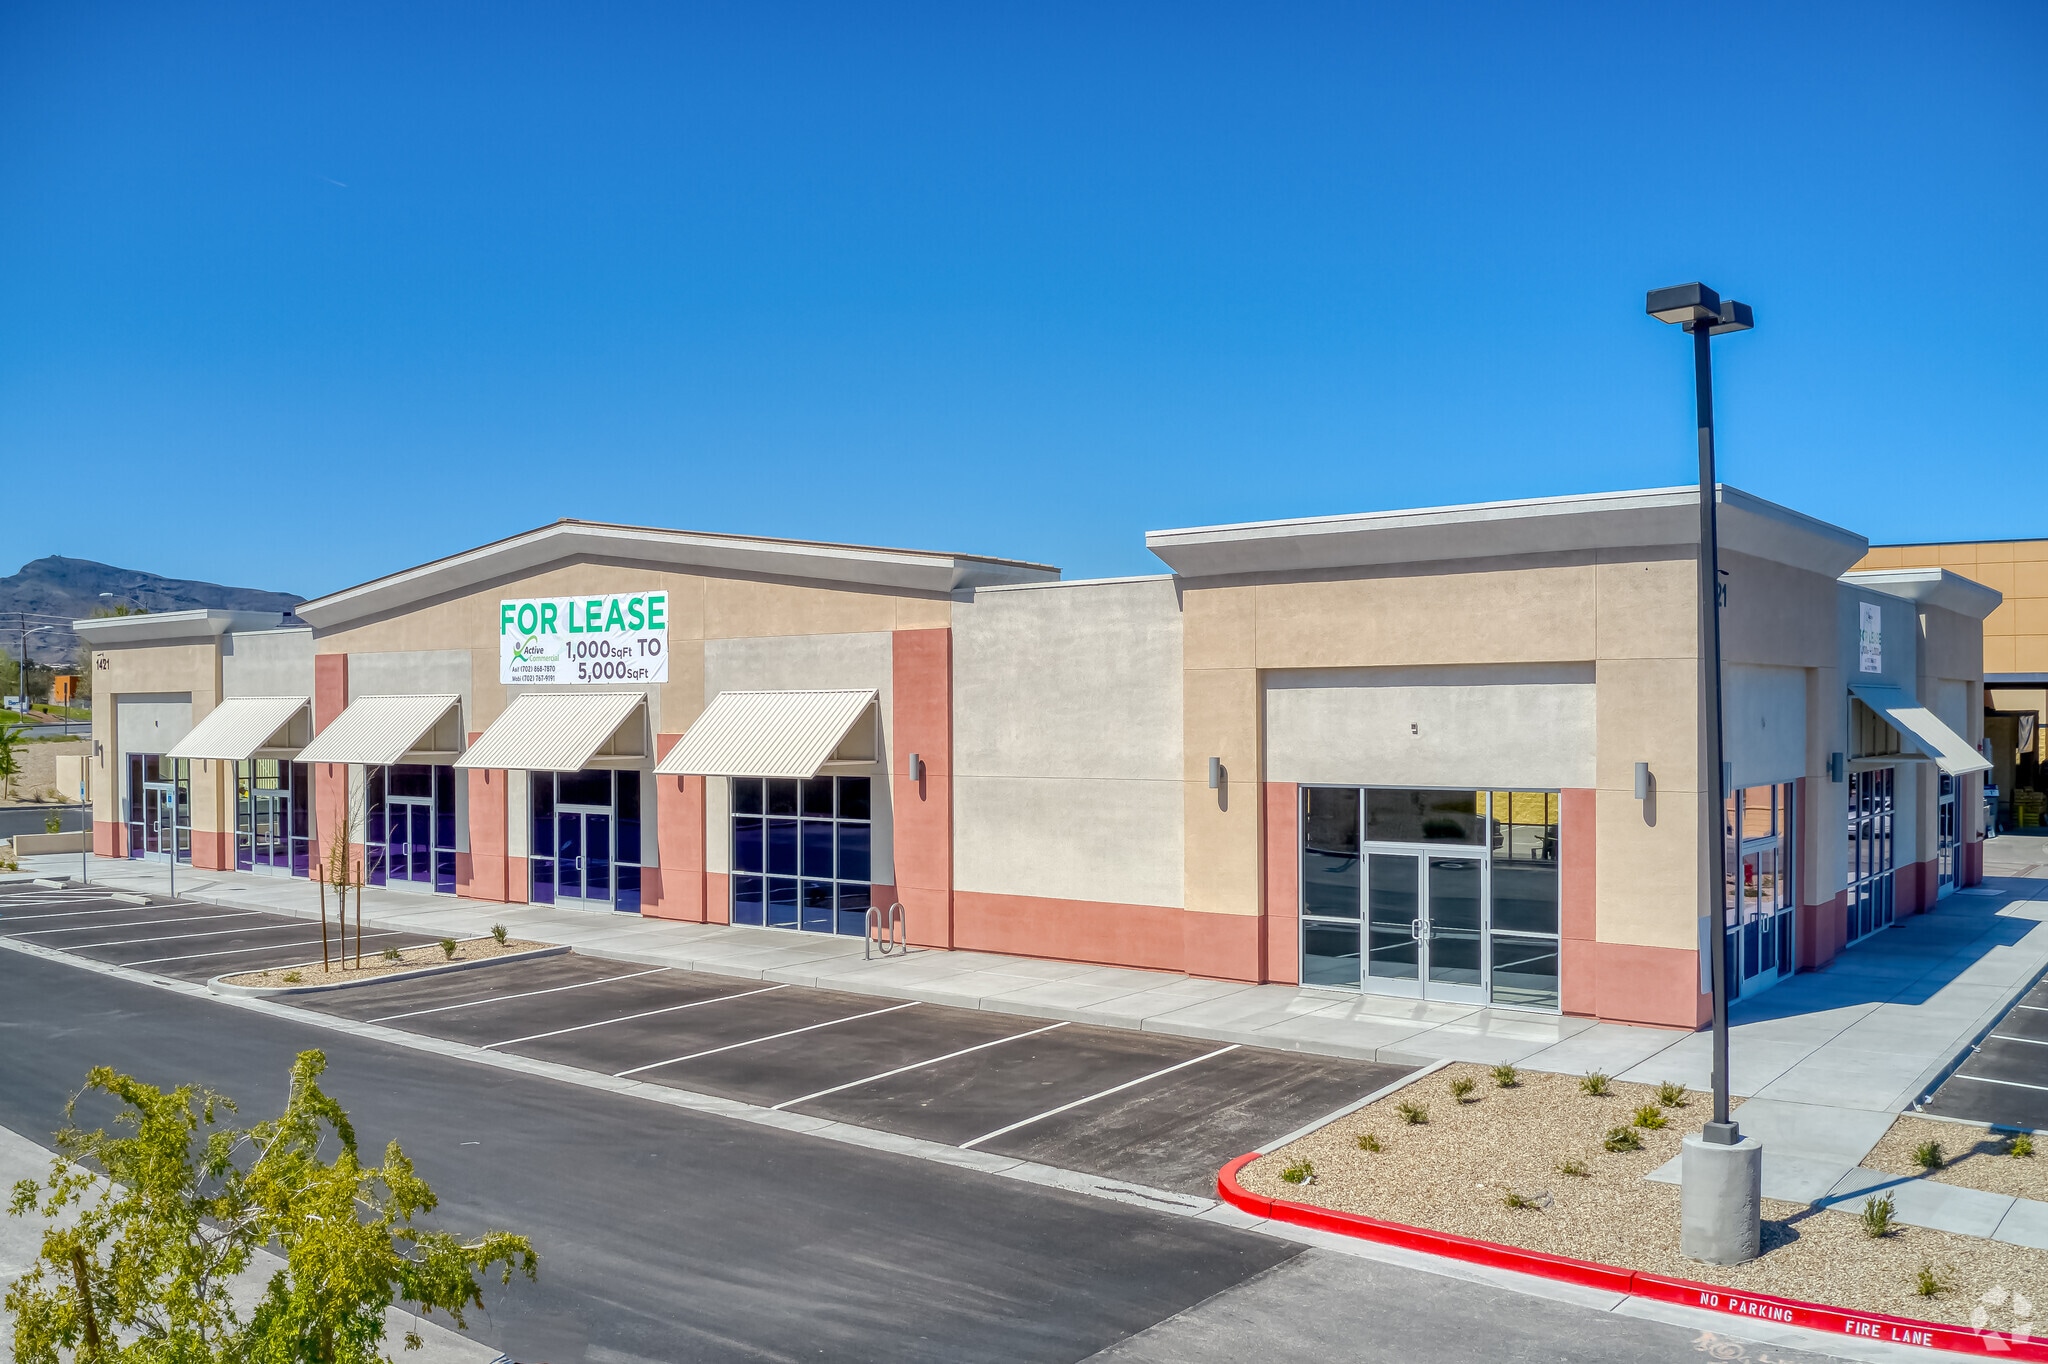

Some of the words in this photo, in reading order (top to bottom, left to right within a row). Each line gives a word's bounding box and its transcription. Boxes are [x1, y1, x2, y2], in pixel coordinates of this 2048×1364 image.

[501, 603, 558, 635] FOR
[568, 595, 666, 634] LEASE
[523, 645, 545, 655] Active
[637, 638, 662, 657] TO
[96, 658, 110, 671] 1421
[529, 654, 560, 662] Commercial
[1699, 1292, 1719, 1307] NO
[1728, 1298, 1793, 1322] PARKING
[1844, 1319, 1881, 1338] FIRE
[1891, 1327, 1934, 1347] LANE
